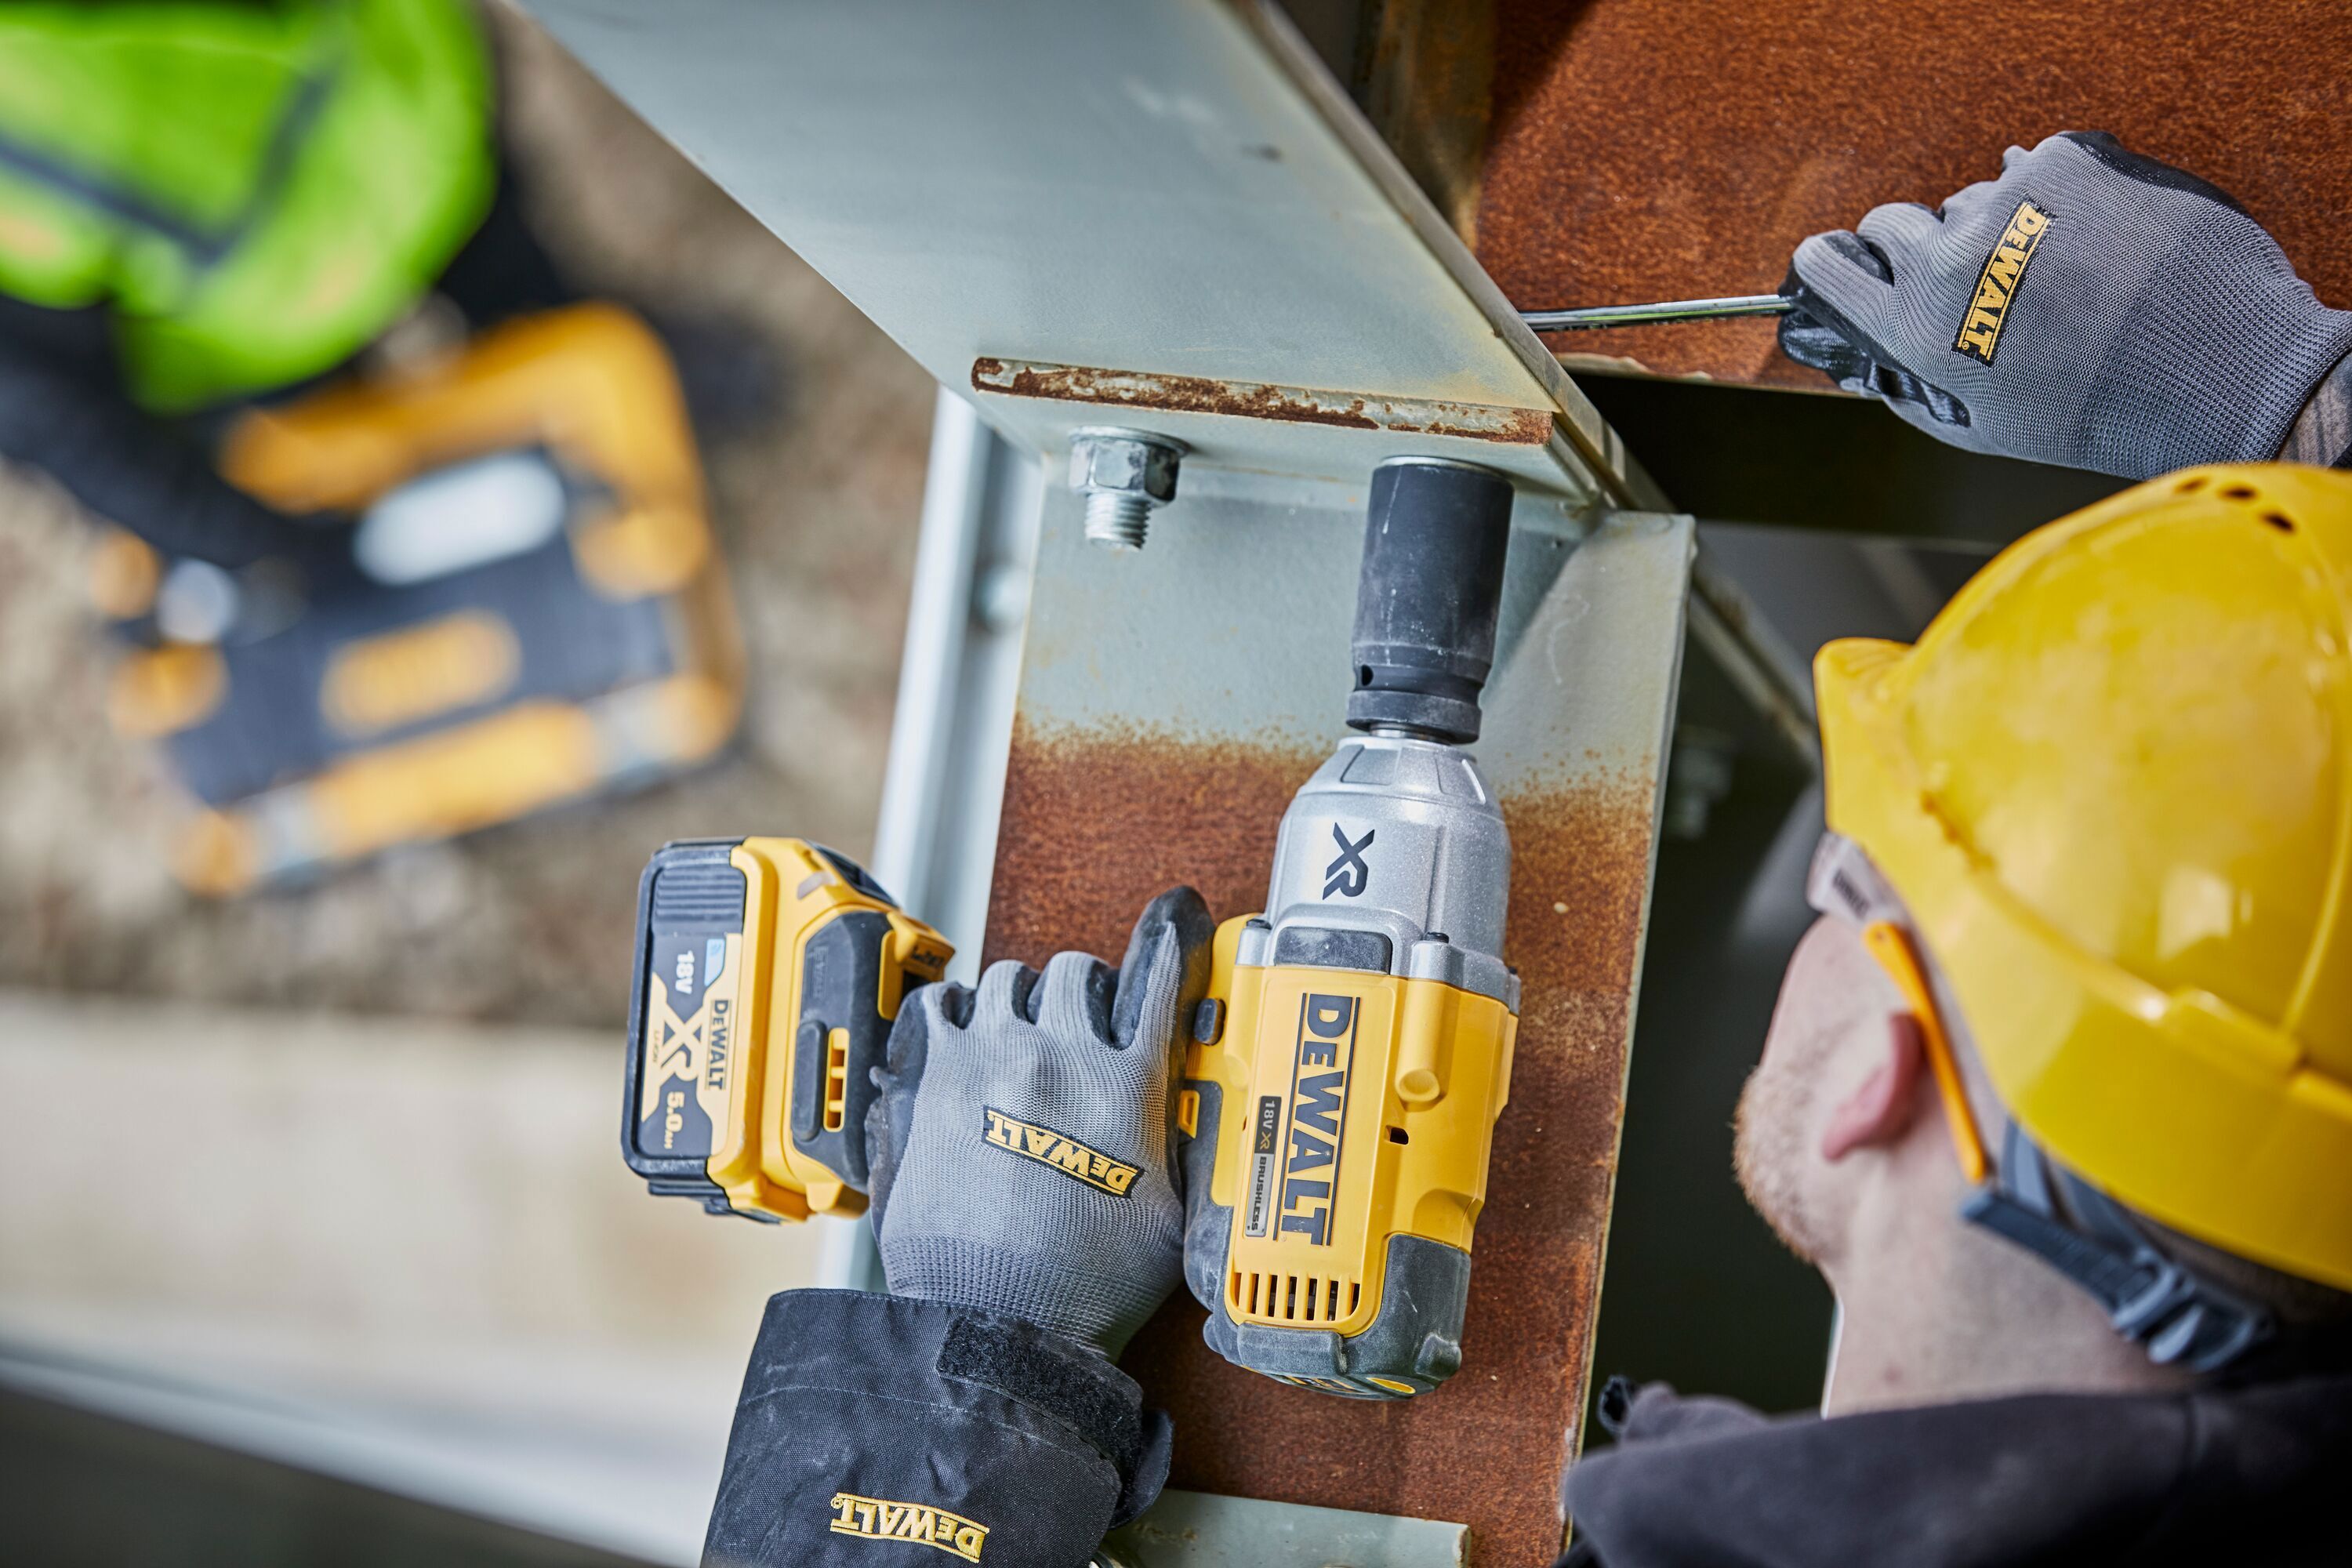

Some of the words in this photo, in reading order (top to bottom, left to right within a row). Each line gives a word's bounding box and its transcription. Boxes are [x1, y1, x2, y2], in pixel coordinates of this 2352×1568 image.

[1964, 204, 2048, 357] DEWALT
[1323, 822, 1375, 901] XR
[675, 950, 695, 995] 18V
[660, 1004, 703, 1085] XR
[1259, 1131, 1272, 1150] XR
[1262, 1100, 1276, 1130] 18V
[1281, 993, 1353, 1246] DEWALT
[988, 1116, 1137, 1192] DEWALT
[1251, 1156, 1267, 1231] BRUSHLESS
[831, 1498, 985, 1559] DEWALT
